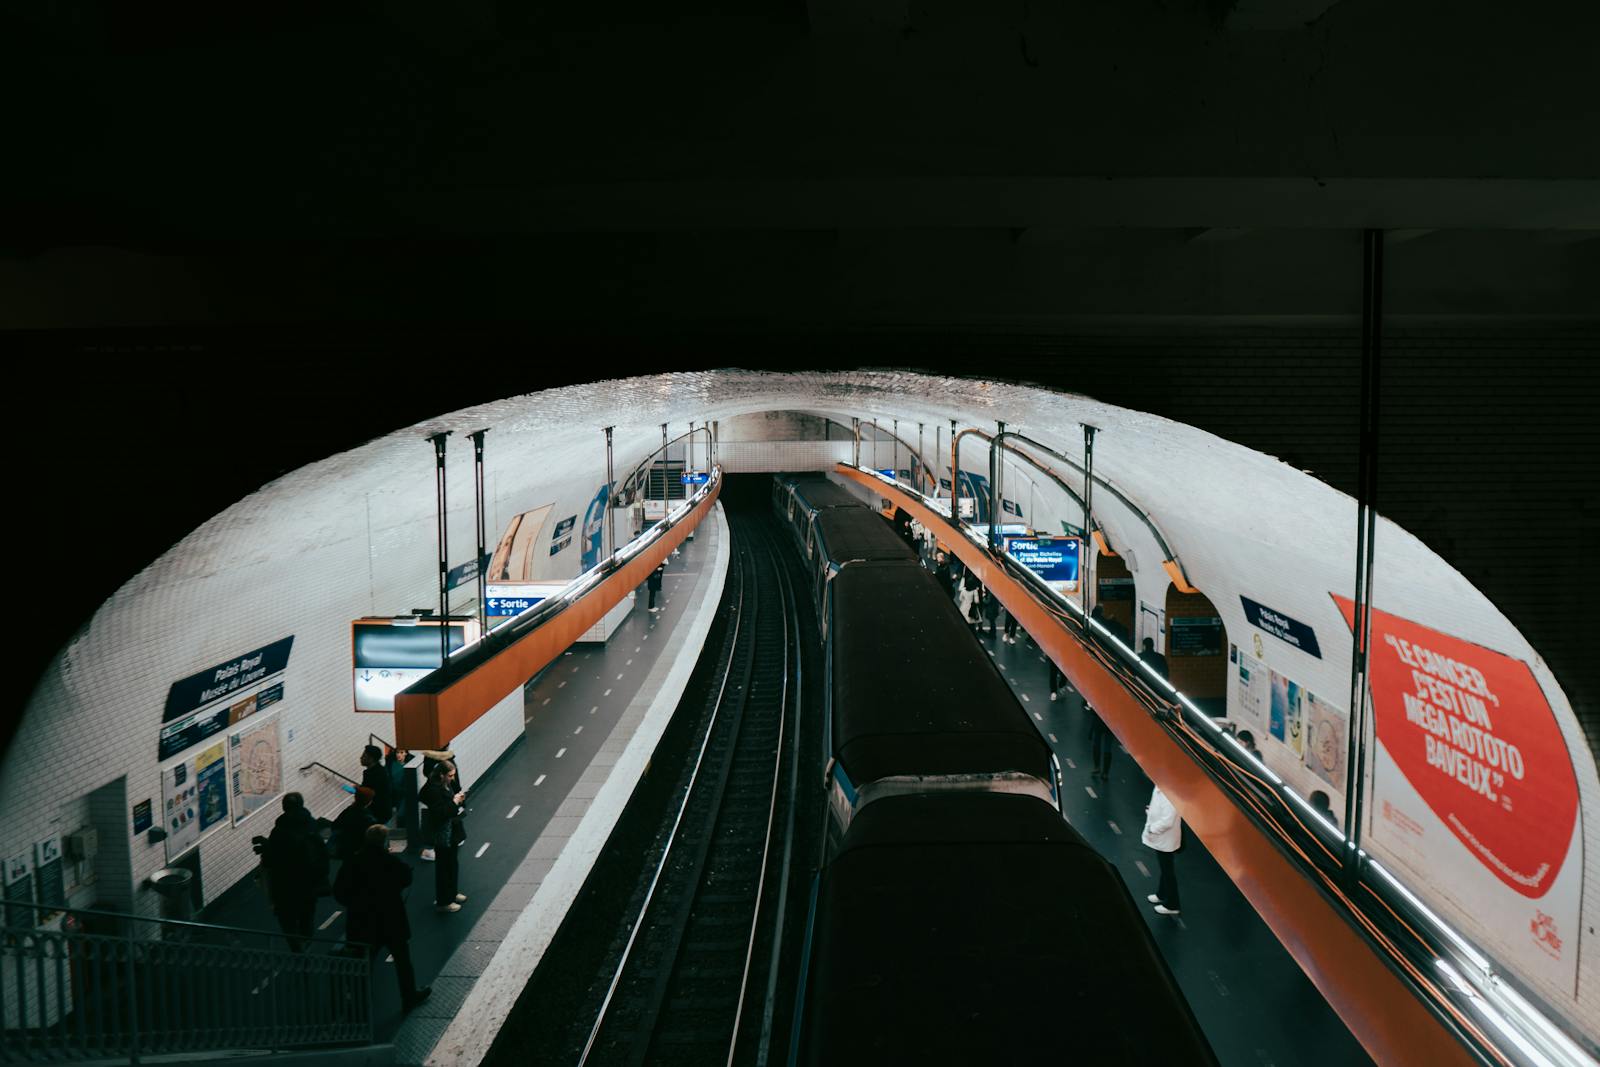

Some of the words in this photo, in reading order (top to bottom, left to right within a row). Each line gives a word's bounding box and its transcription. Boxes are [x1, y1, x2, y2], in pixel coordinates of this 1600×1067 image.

[1012, 542, 1038, 550] Sortie
[500, 599, 529, 608] Sortie
[200, 684, 228, 703] Musée
[229, 678, 239, 690] du
[241, 667, 265, 685] Louvre
[215, 664, 239, 682] Palais
[240, 653, 263, 671] Royal
[1412, 644, 1500, 707] CANCER,
[1457, 690, 1492, 730] UN
[1449, 715, 1525, 780] ROTOTO
